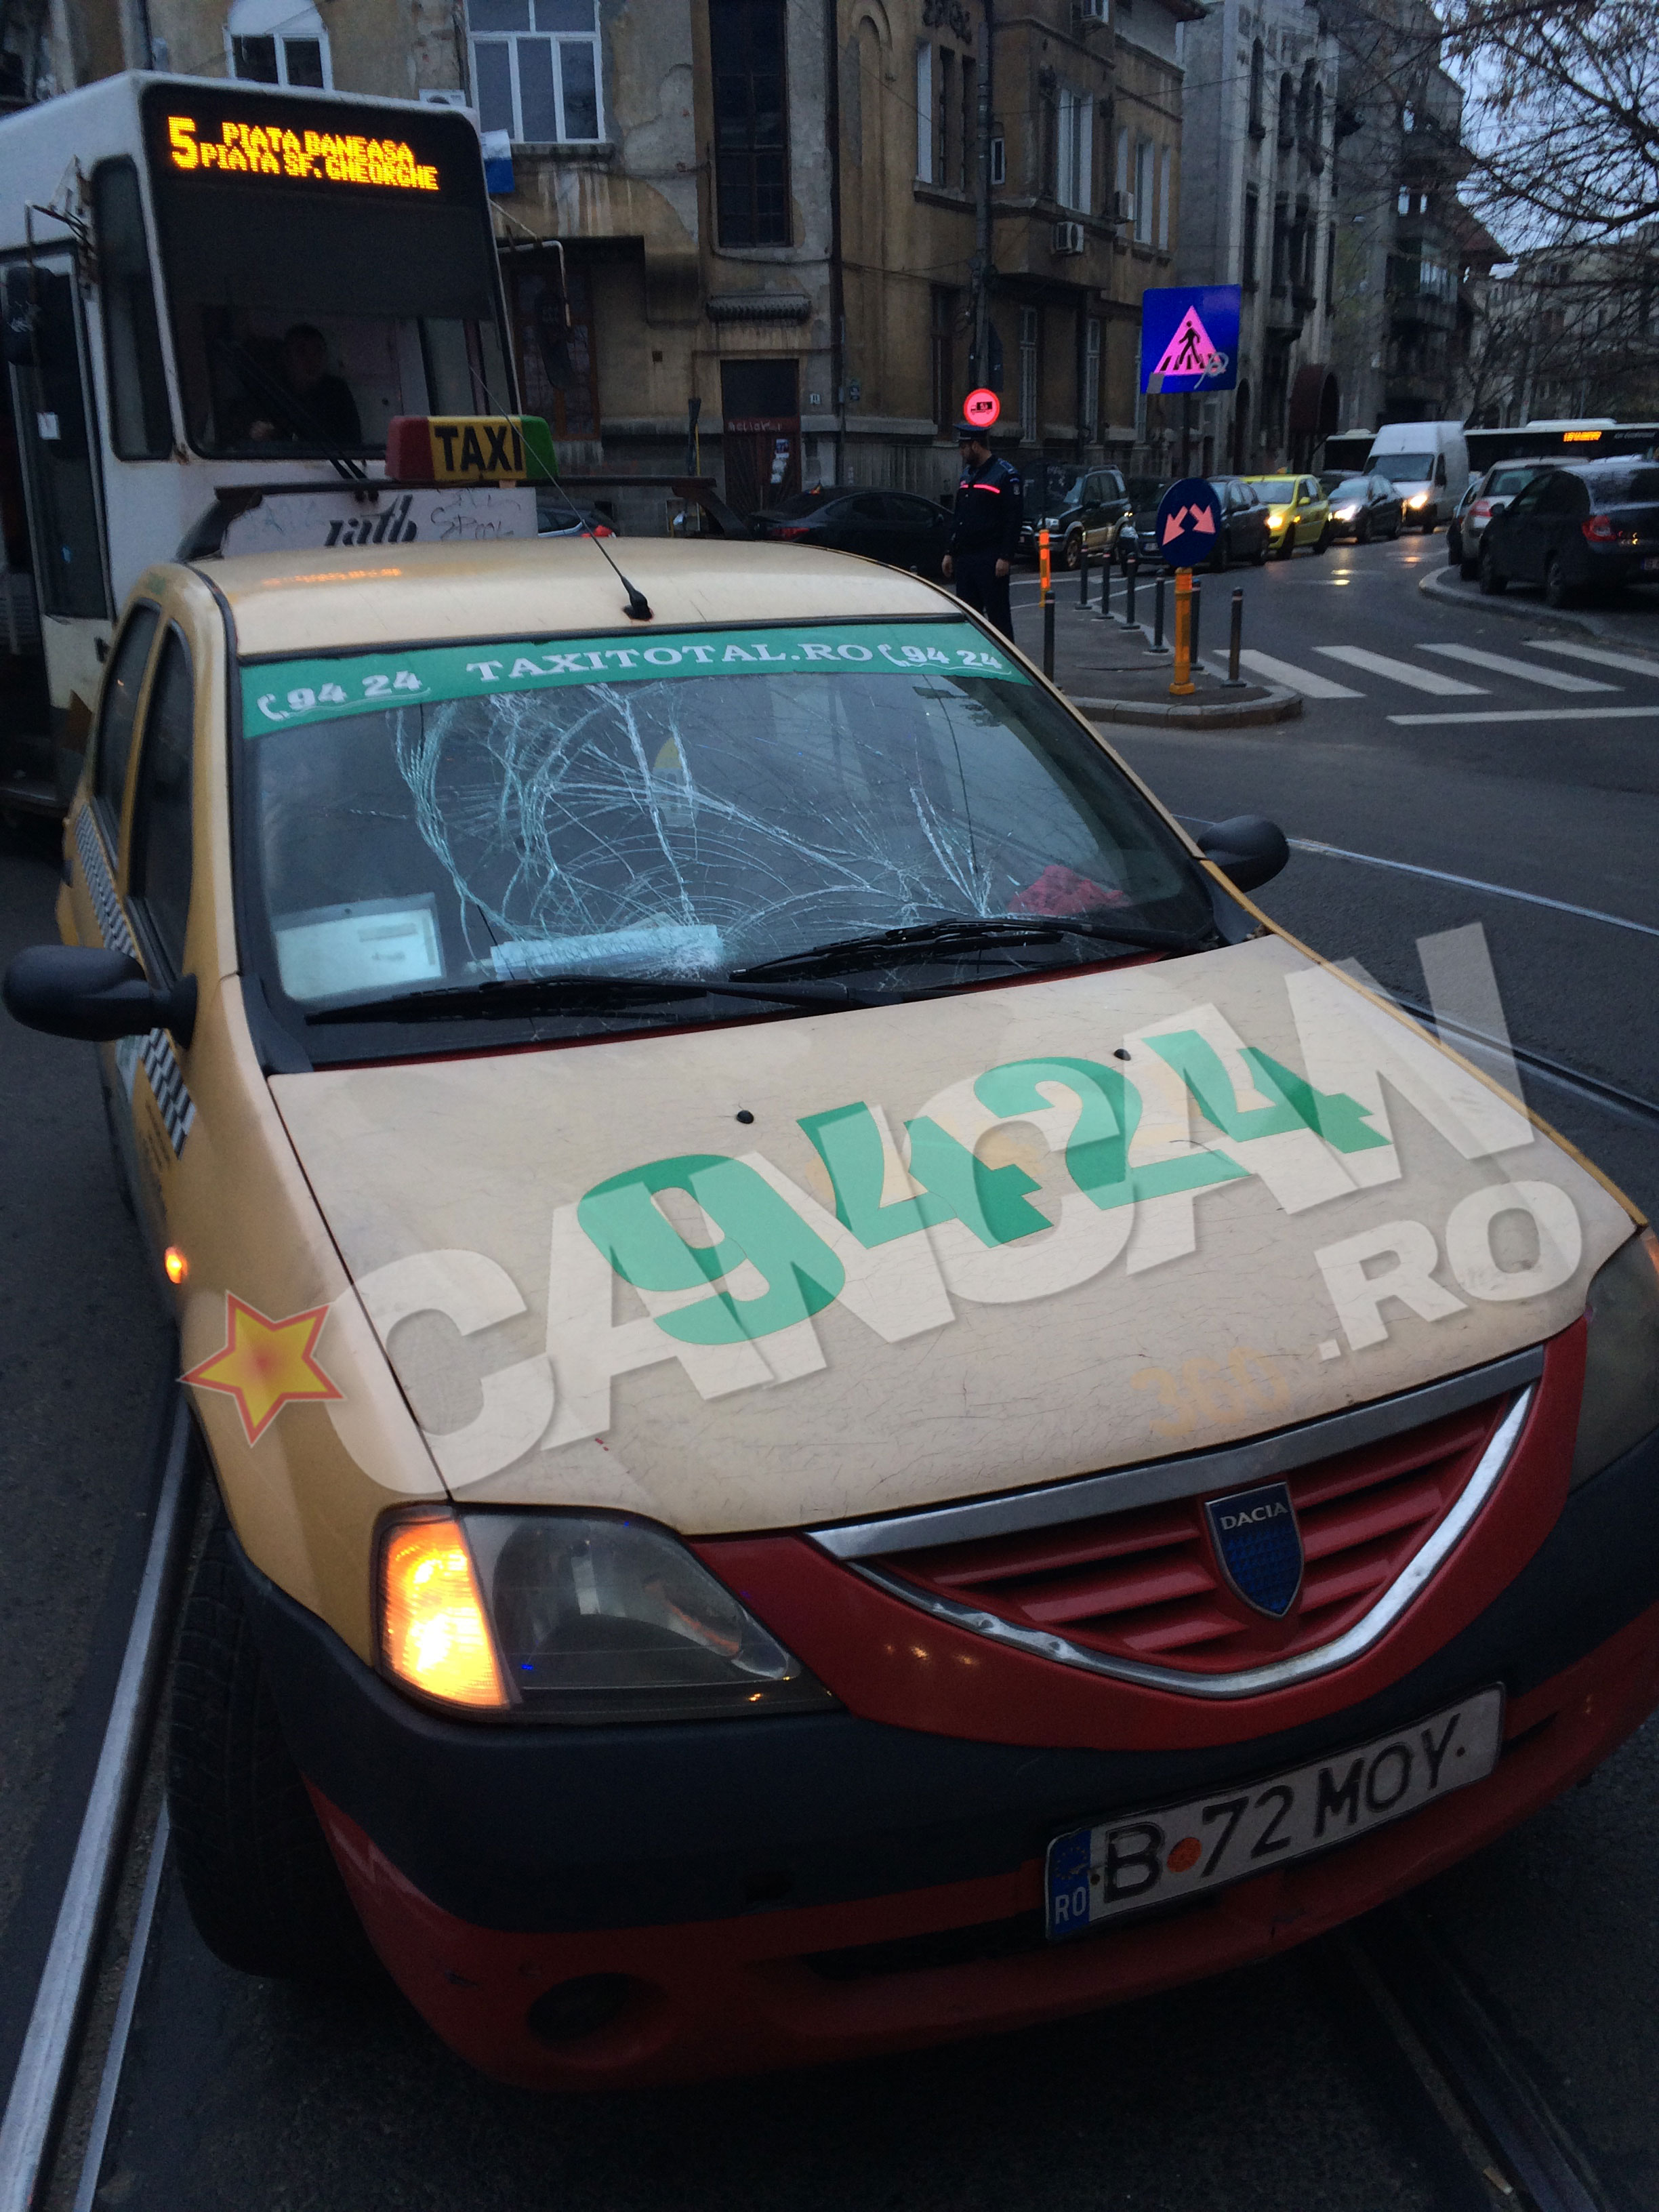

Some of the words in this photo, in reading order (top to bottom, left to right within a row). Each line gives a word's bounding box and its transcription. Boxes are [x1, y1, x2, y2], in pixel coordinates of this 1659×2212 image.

[168, 117, 199, 169] 5
[222, 122, 302, 155] PIATA
[304, 130, 415, 169] BANEASA
[200, 142, 281, 174] PIATA
[325, 155, 441, 191] GHEORGHE
[434, 425, 523, 472] TAXI
[466, 642, 874, 682] TAXITOTAL.RO
[901, 644, 950, 664] 94
[955, 649, 1002, 670] 24
[287, 682, 348, 710] 94
[361, 670, 423, 698] 24
[1221, 1502, 1288, 1530] DACIA
[1103, 1822, 1164, 1904] B
[1201, 1784, 1296, 1877] 72
[1313, 1713, 1461, 1839] MOY
[1055, 1886, 1087, 1925] RO
